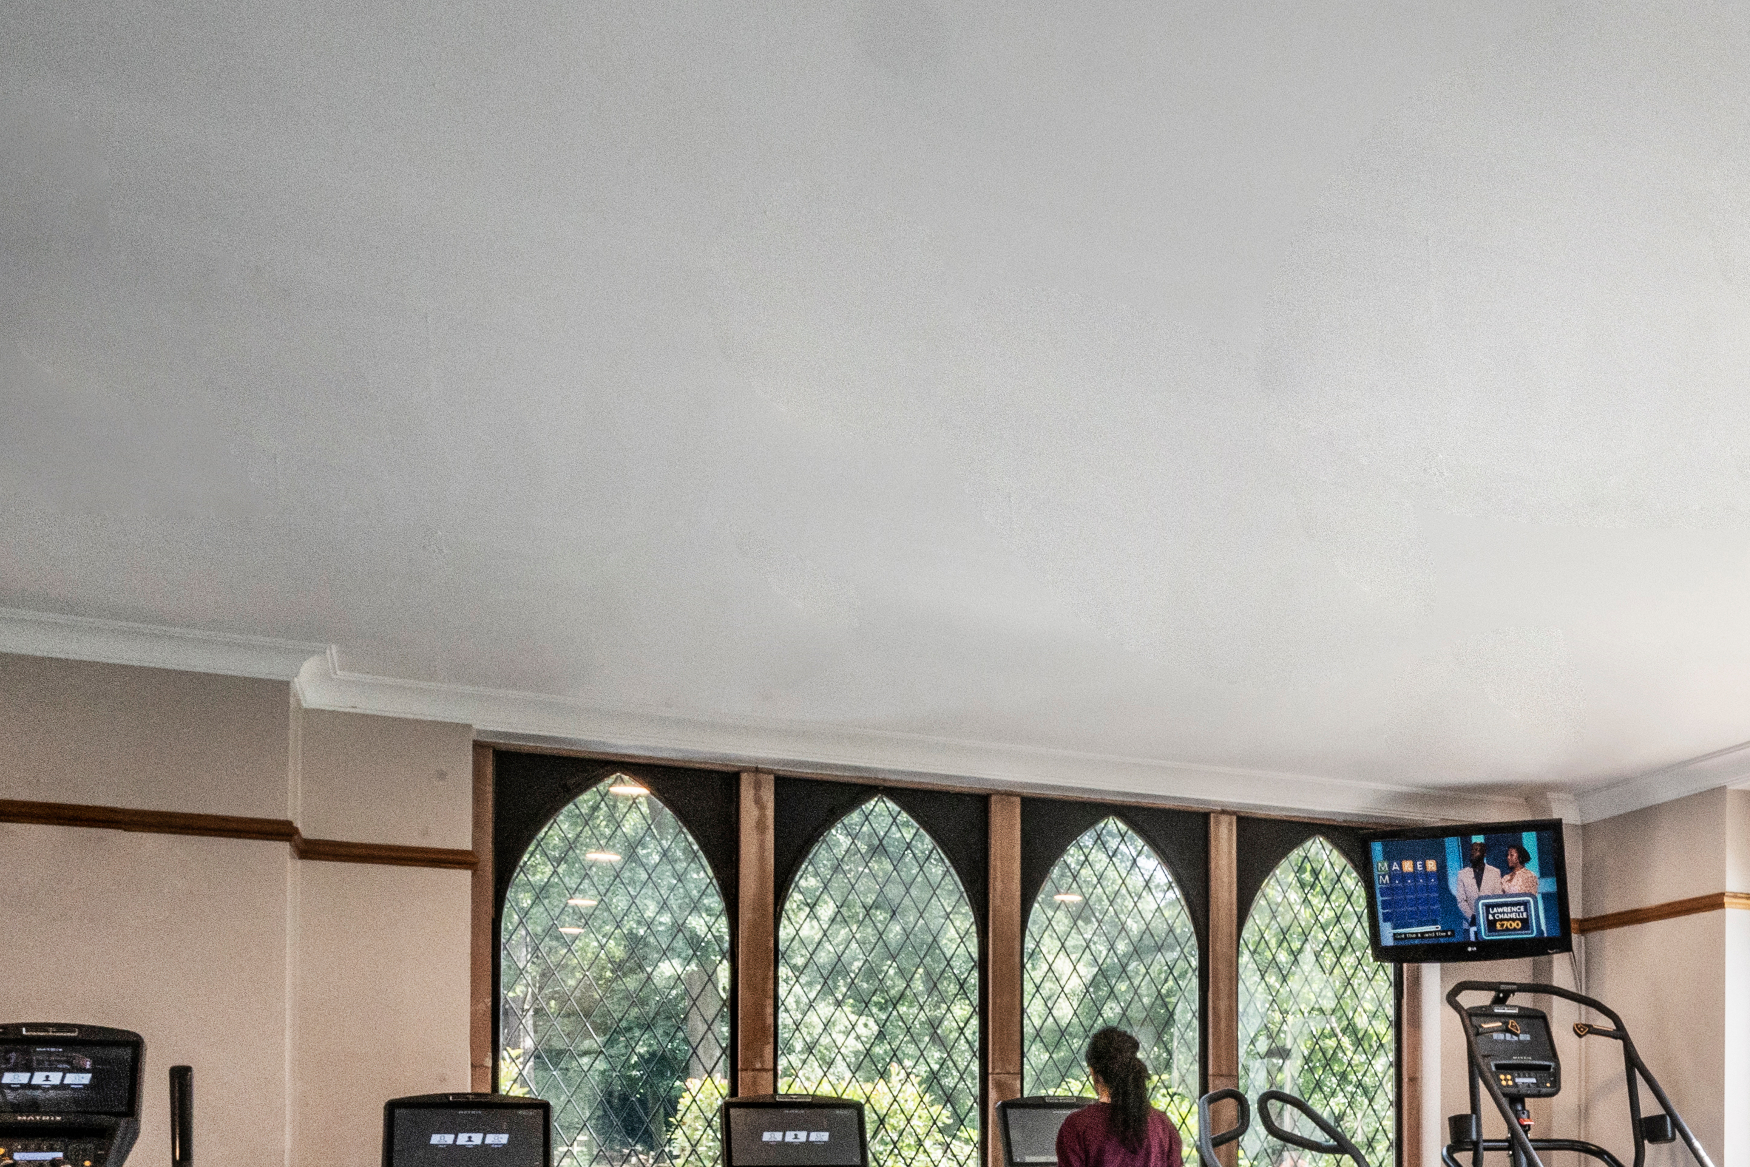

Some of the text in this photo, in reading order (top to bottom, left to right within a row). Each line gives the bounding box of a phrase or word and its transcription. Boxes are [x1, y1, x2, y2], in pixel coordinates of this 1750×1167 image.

[1378, 861, 1435, 870] MAKER
[1490, 905, 1525, 914] LAWRENCE
[1496, 920, 1521, 930] £700
